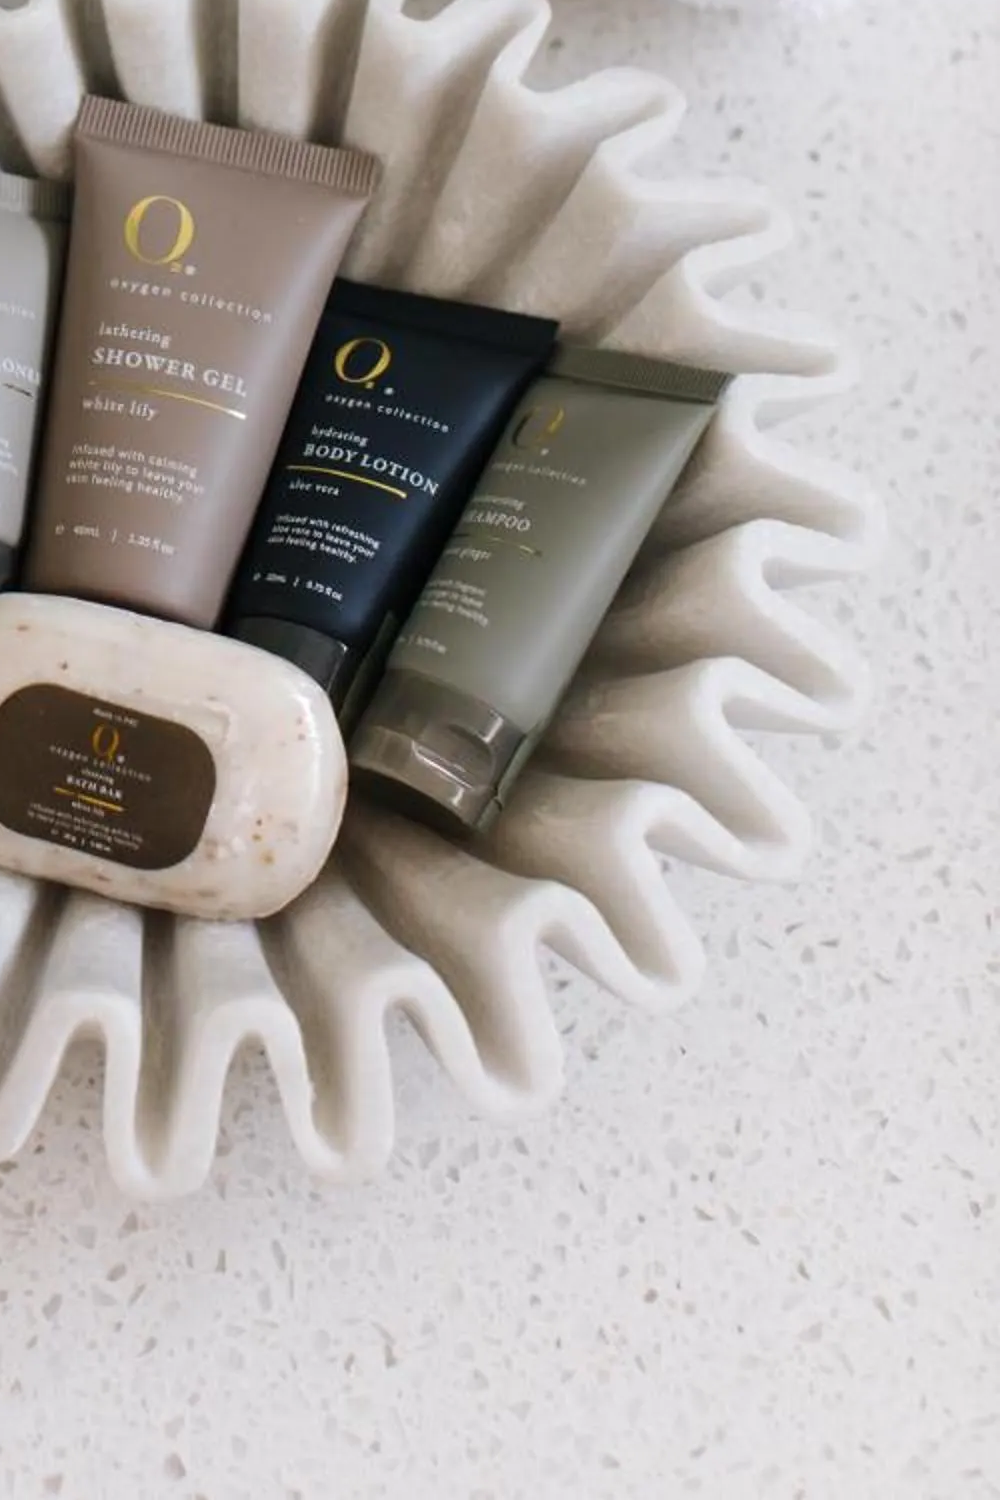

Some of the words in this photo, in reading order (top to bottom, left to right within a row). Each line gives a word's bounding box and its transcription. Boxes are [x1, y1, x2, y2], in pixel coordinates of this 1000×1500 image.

[110, 277, 172, 296] oxygen
[180, 290, 272, 324] collection
[99, 321, 172, 349] lathering
[91, 346, 196, 381] SHOWER
[202, 368, 248, 398] GEL
[82, 394, 124, 414] white
[129, 400, 160, 422] lily
[325, 393, 371, 409] oxygen
[377, 405, 449, 433] collection
[311, 423, 369, 447] hydrating
[69, 458, 100, 471] white
[103, 460, 122, 475] lily
[125, 465, 139, 476] to
[142, 467, 175, 485] leave
[72, 443, 115, 458] infused
[118, 450, 145, 462] with
[148, 455, 197, 479] calming
[303, 443, 358, 463] BODY
[360, 454, 439, 496] LOTION
[91, 474, 134, 493] feeling
[289, 478, 312, 492] aloe
[315, 484, 340, 496] vera
[331, 523, 380, 550] refreshing
